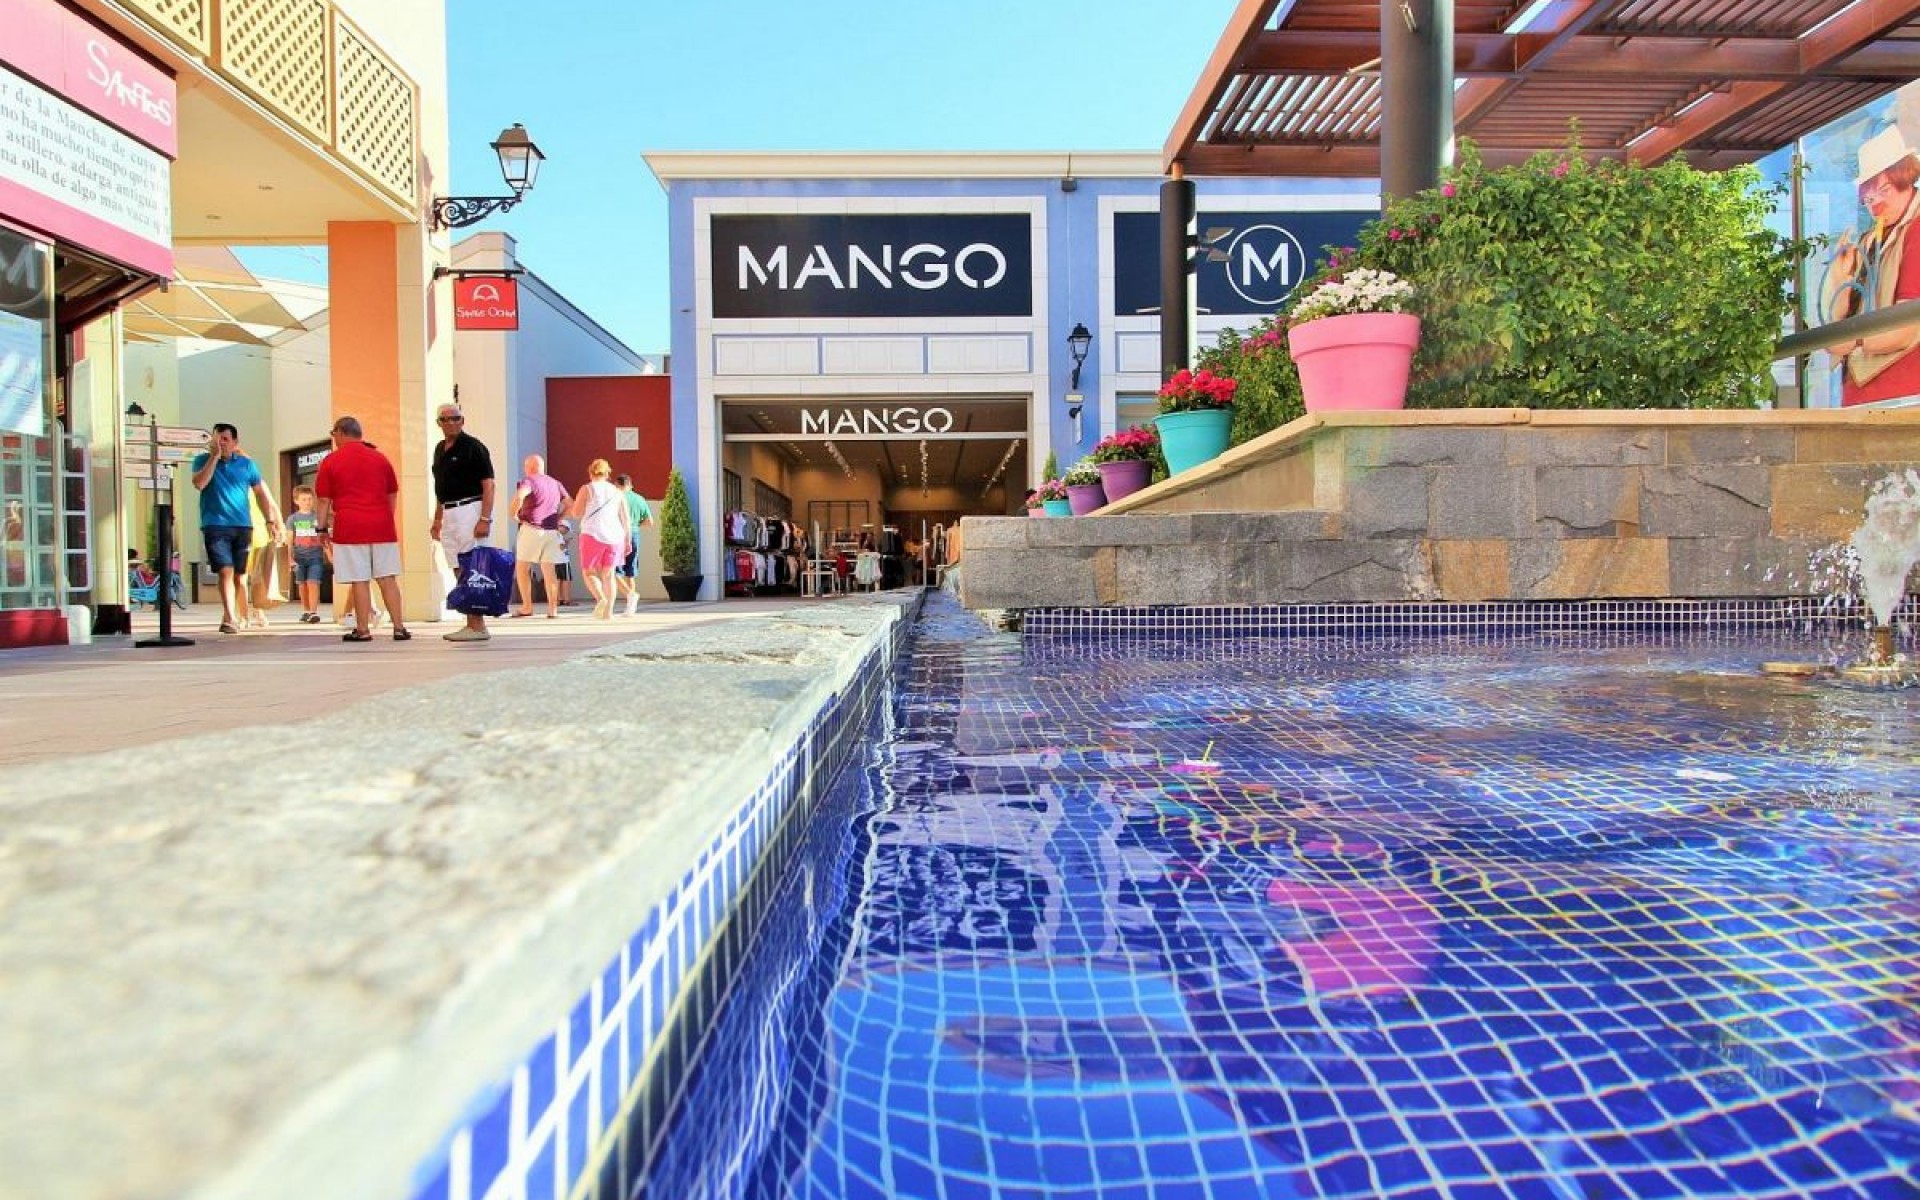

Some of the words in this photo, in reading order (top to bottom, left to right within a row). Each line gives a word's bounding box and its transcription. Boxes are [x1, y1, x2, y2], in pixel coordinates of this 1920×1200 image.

[15, 87, 33, 107] de
[38, 97, 50, 117] la
[57, 108, 107, 148] Mancha
[22, 110, 38, 131] ha
[41, 125, 84, 155] mucho
[86, 147, 127, 177] tiempo
[22, 157, 47, 178] olla
[51, 170, 67, 188] de
[71, 179, 97, 202] algo
[71, 160, 112, 189] adarga
[737, 242, 1007, 290] MANGO
[1242, 242, 1289, 286] M
[799, 407, 954, 434] MANGO
